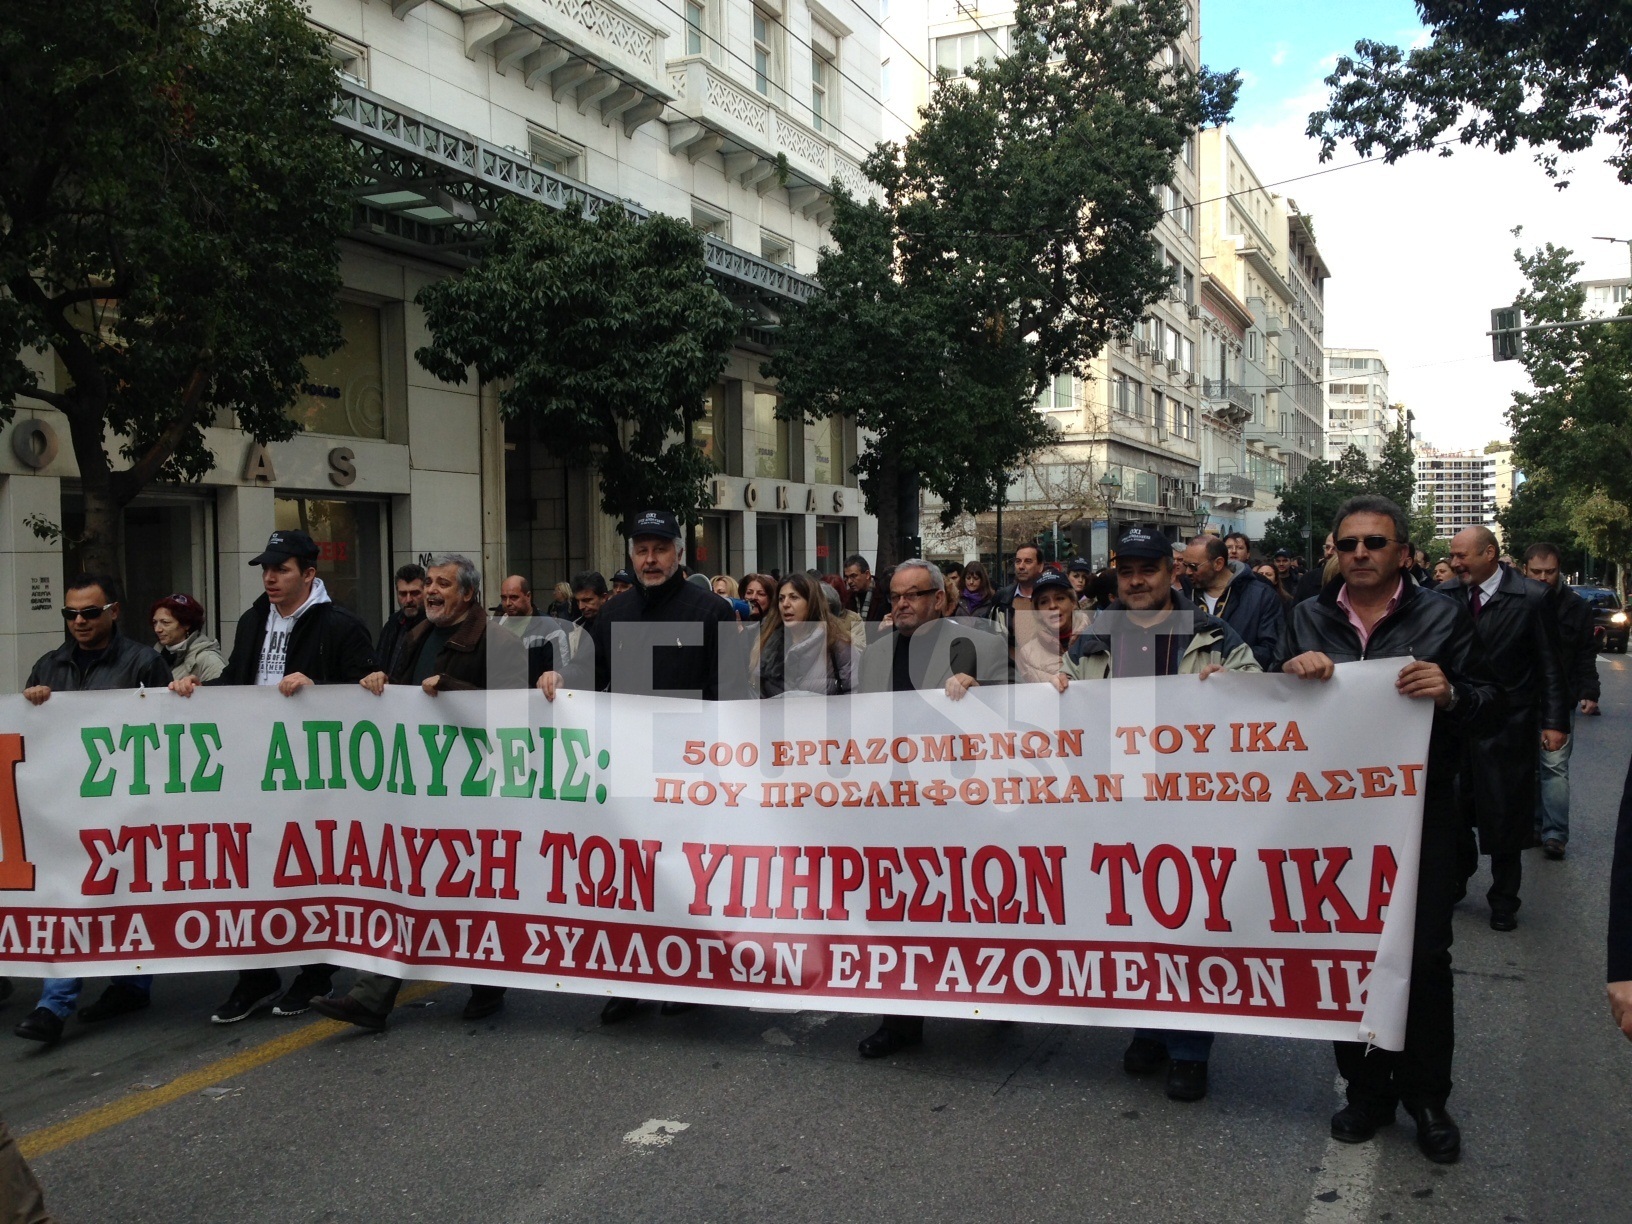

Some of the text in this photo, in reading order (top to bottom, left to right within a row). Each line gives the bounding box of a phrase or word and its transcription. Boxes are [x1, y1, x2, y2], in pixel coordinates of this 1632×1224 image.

[712, 480, 844, 514] FOKAS
[79, 720, 611, 804] ΣΤΙΣ ΑΠΟΛΥΣΕΙΣ:
[683, 721, 1308, 767] 500 ΕΡΓΑΖΟΜΕΝΩΝ ΤΟΥ ΙΚΑ
[654, 778, 747, 807] ΠΟΥ
[760, 774, 1125, 808] ΠΡΟΣΛΗΦΘΗΚΑΝ
[1144, 771, 1272, 802] ΜΕΣΩ
[79, 819, 1399, 934] ΣΤΗΝ ΔΙΑΛΥΣΗ ΤΩΝ ΥΠΗΡΕΣΙΩΝ ΤΟΥ ΙΚΑ
[174, 904, 505, 962] ΟΜΟΣΠΟΝΔΙΑ
[522, 923, 808, 987] ΣΥΛΛΟΓΩΝ
[827, 943, 1286, 1008] ΕΡΓΑΖΟΜΕΝΩΝ
